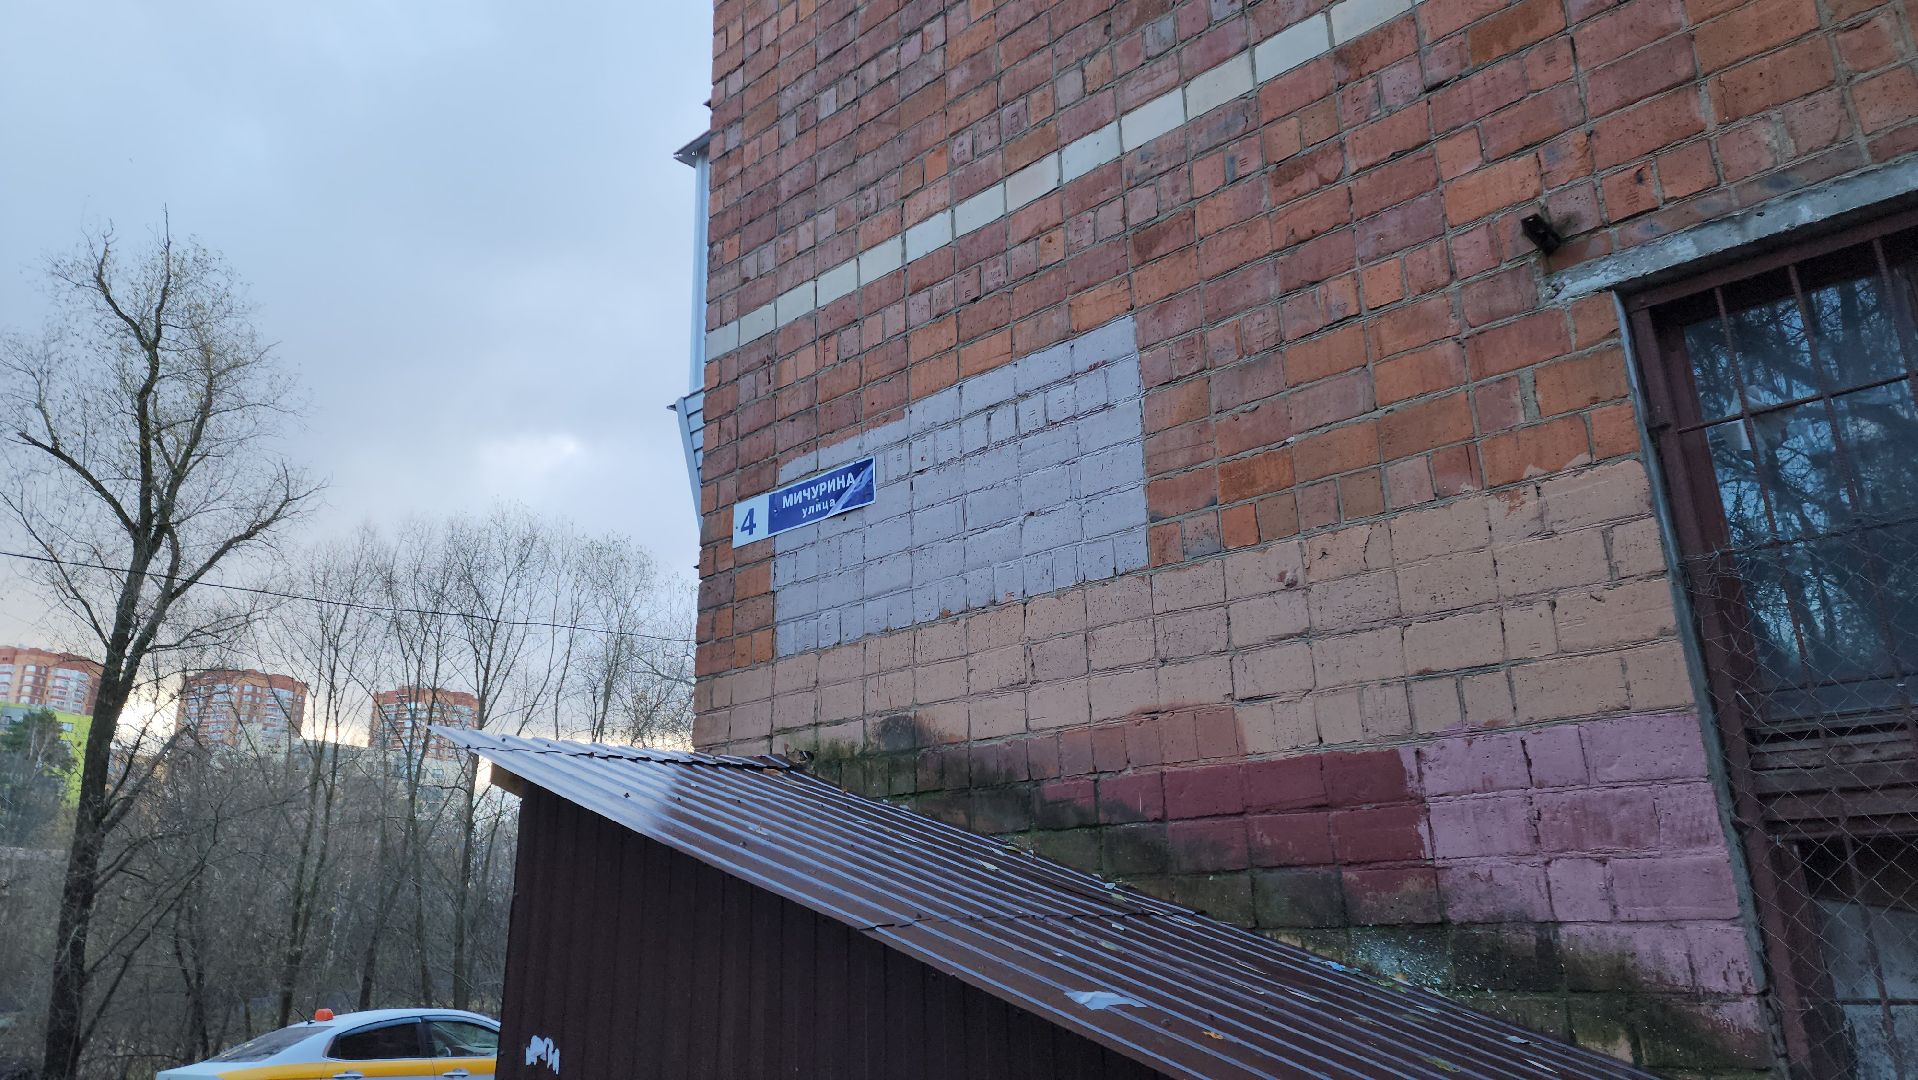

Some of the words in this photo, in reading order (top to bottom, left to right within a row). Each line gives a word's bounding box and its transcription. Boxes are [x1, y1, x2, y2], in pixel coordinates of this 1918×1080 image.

[782, 472, 856, 509] МИЧУРИНА
[740, 507, 757, 536] 4
[802, 498, 837, 518] улица
